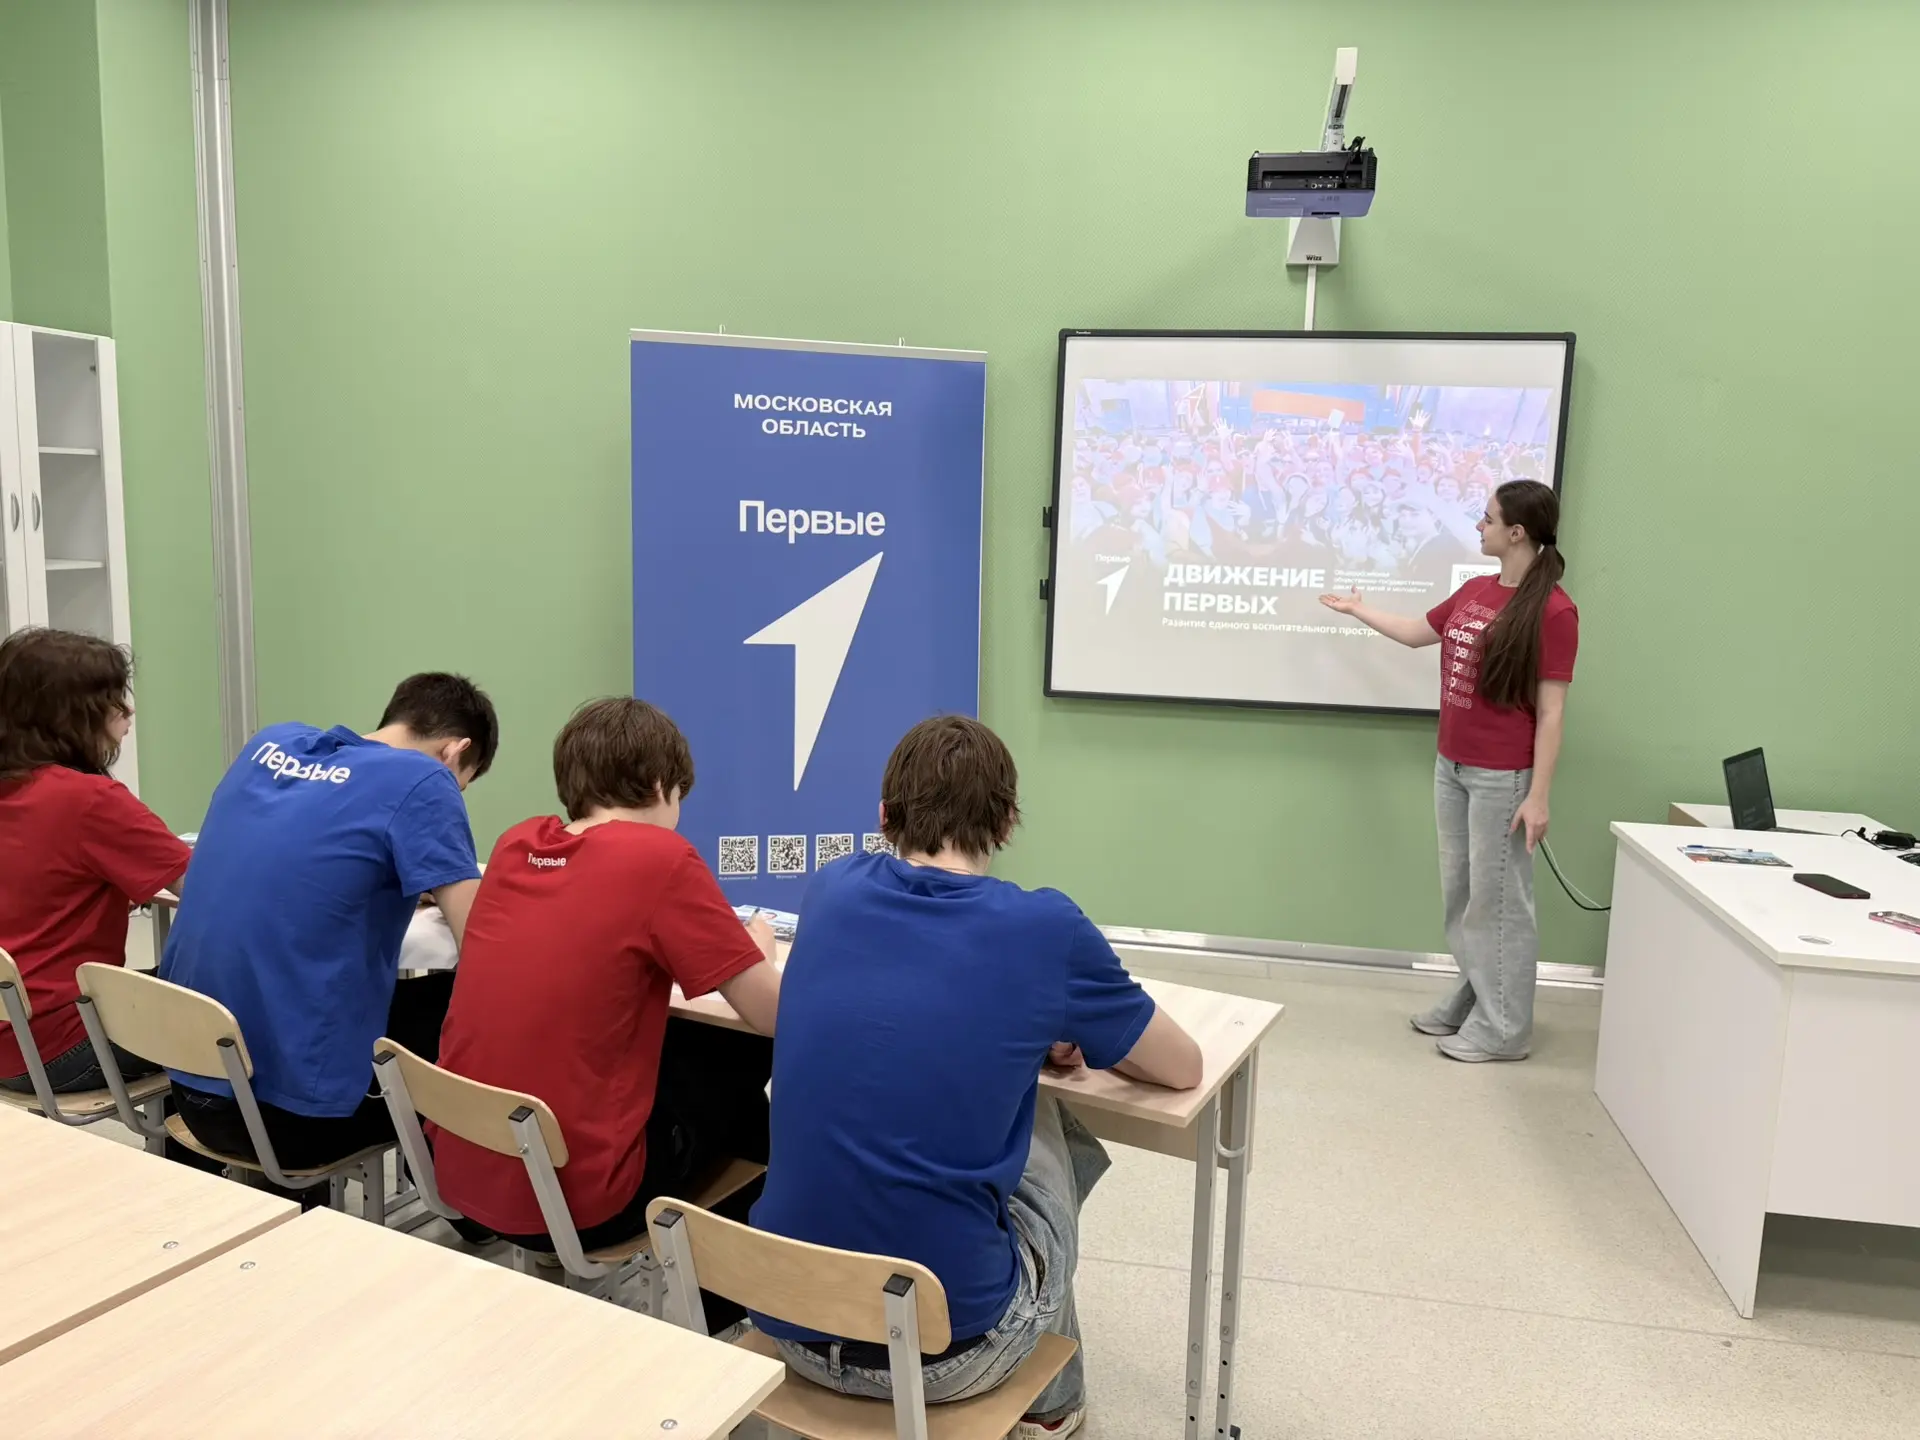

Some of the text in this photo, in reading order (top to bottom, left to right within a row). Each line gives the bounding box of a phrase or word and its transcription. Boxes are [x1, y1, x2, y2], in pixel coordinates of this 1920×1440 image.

[733, 393, 892, 416] МОСКОВСКАЯ
[761, 418, 867, 438] ОБЛАСТЬ
[739, 500, 886, 544] Первые
[1163, 563, 1326, 588] ДВИЖЕНИЕ
[1163, 592, 1279, 615] ПЕРВЫХ
[1162, 617, 1206, 629] Развитие
[1209, 620, 1250, 631] единого
[1252, 621, 1336, 635] воспитательного
